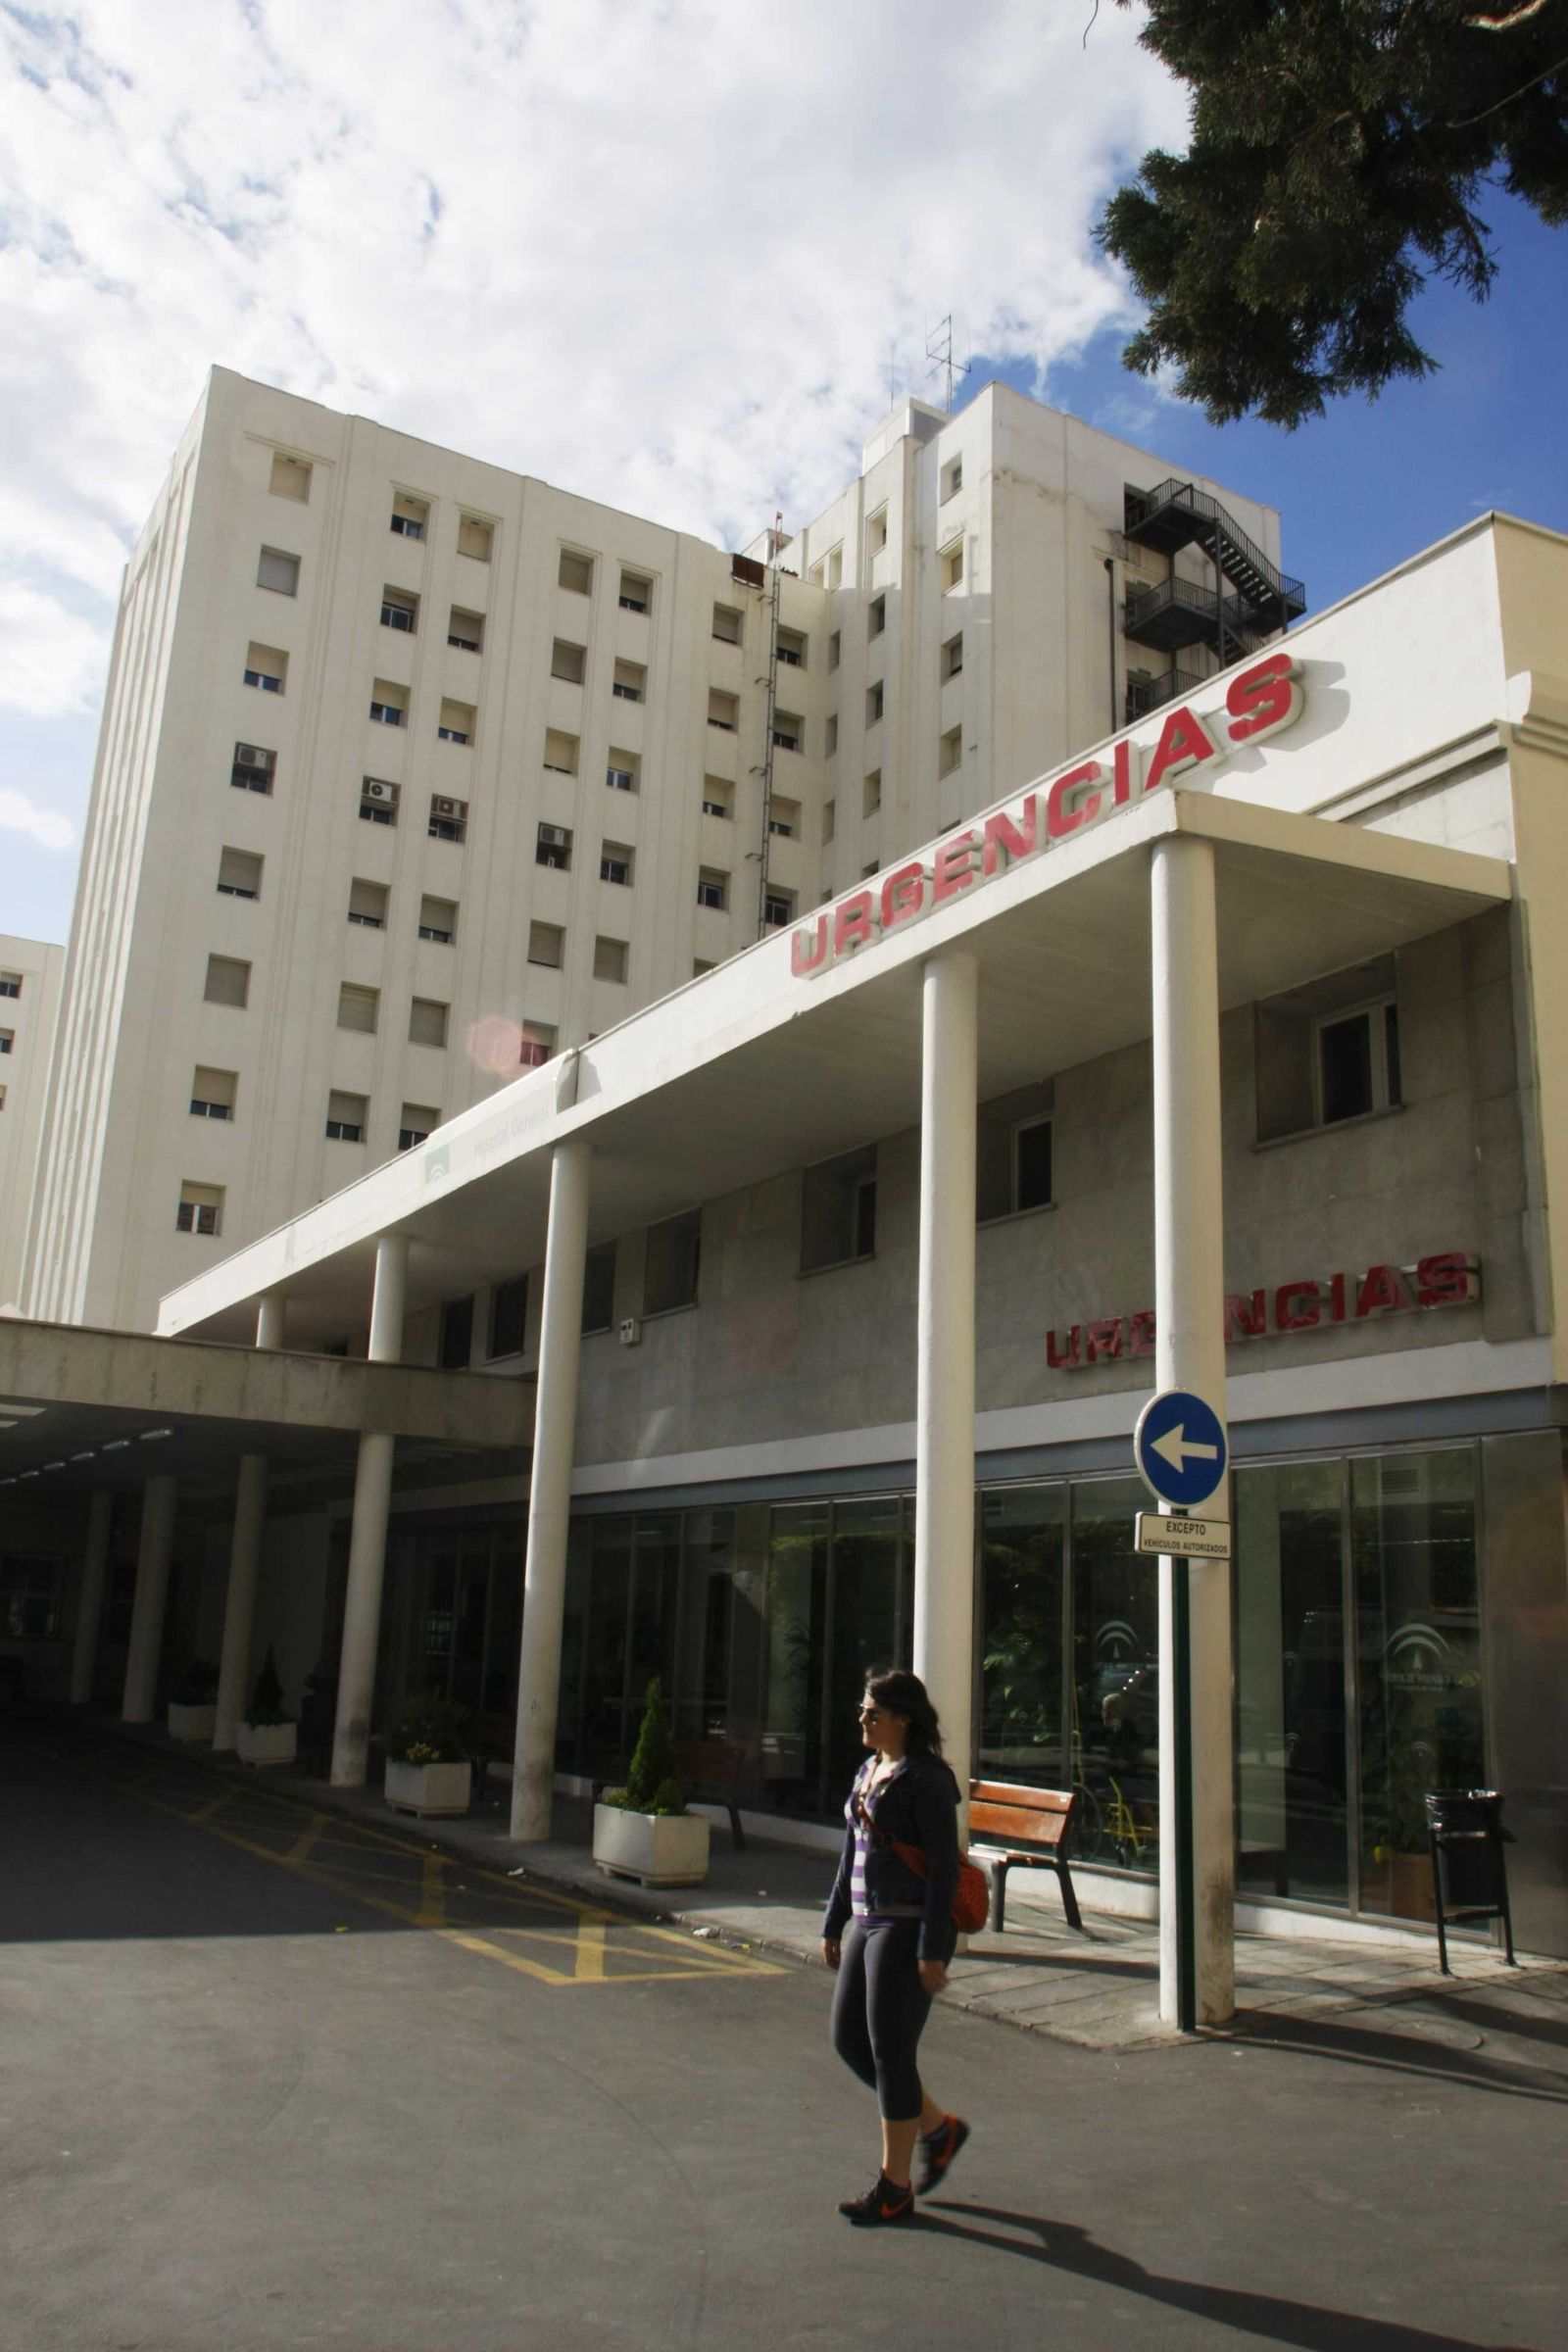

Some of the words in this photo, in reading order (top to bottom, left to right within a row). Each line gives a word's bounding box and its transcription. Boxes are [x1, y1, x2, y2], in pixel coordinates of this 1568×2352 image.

[790, 653, 1296, 979] URGENCIAS
[1046, 1250, 1469, 1369] URGNCIAS
[1166, 1520, 1206, 1536] EXCEPTO
[1183, 1542, 1228, 1554] AUTORIZADOS
